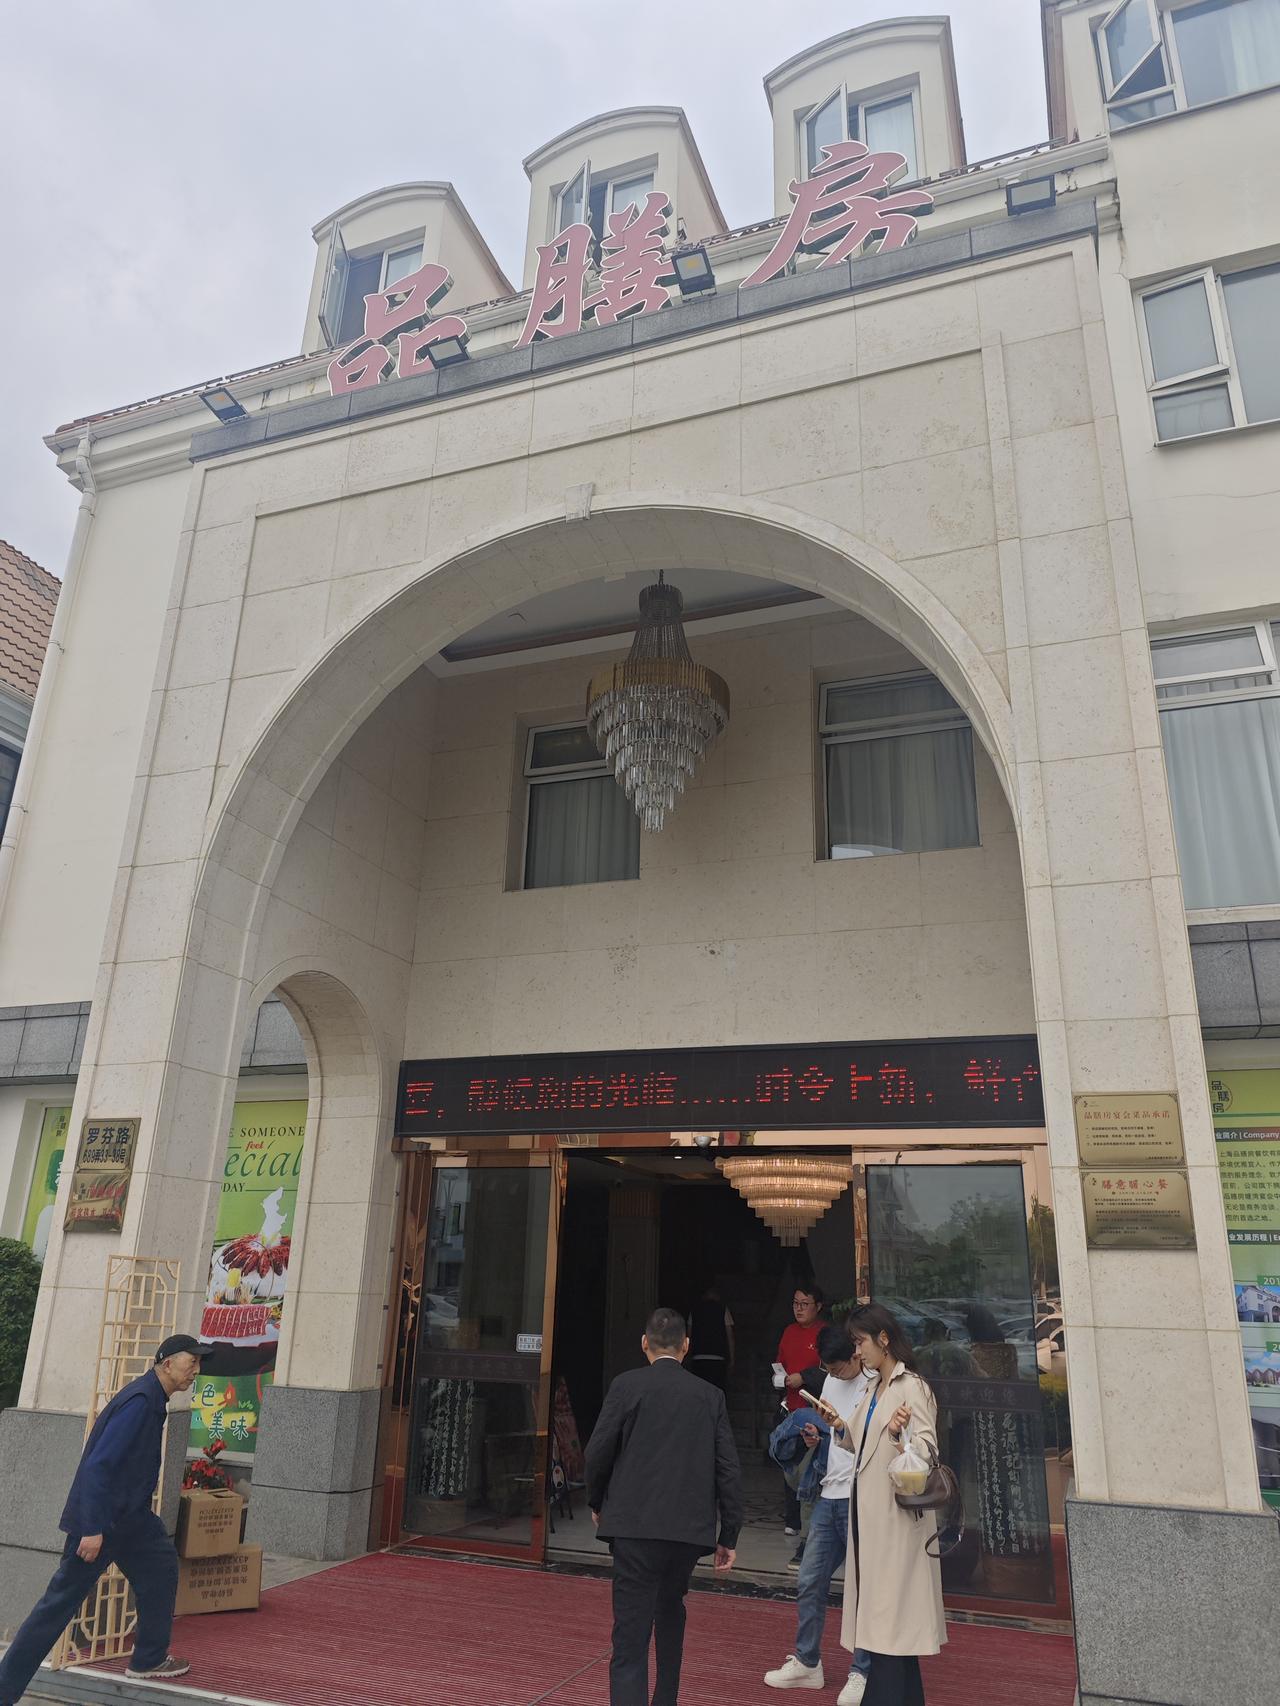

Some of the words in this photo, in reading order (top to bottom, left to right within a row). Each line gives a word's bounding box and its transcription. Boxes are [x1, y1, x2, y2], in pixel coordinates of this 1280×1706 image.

[326, 139, 935, 395] 品膳房
[87, 1127, 130, 1145] 罗芬路
[240, 1126, 305, 1138] SOMEONE
[245, 1141, 265, 1154] feel
[221, 1182, 245, 1193] DAY
[209, 1411, 249, 1441] 美味
